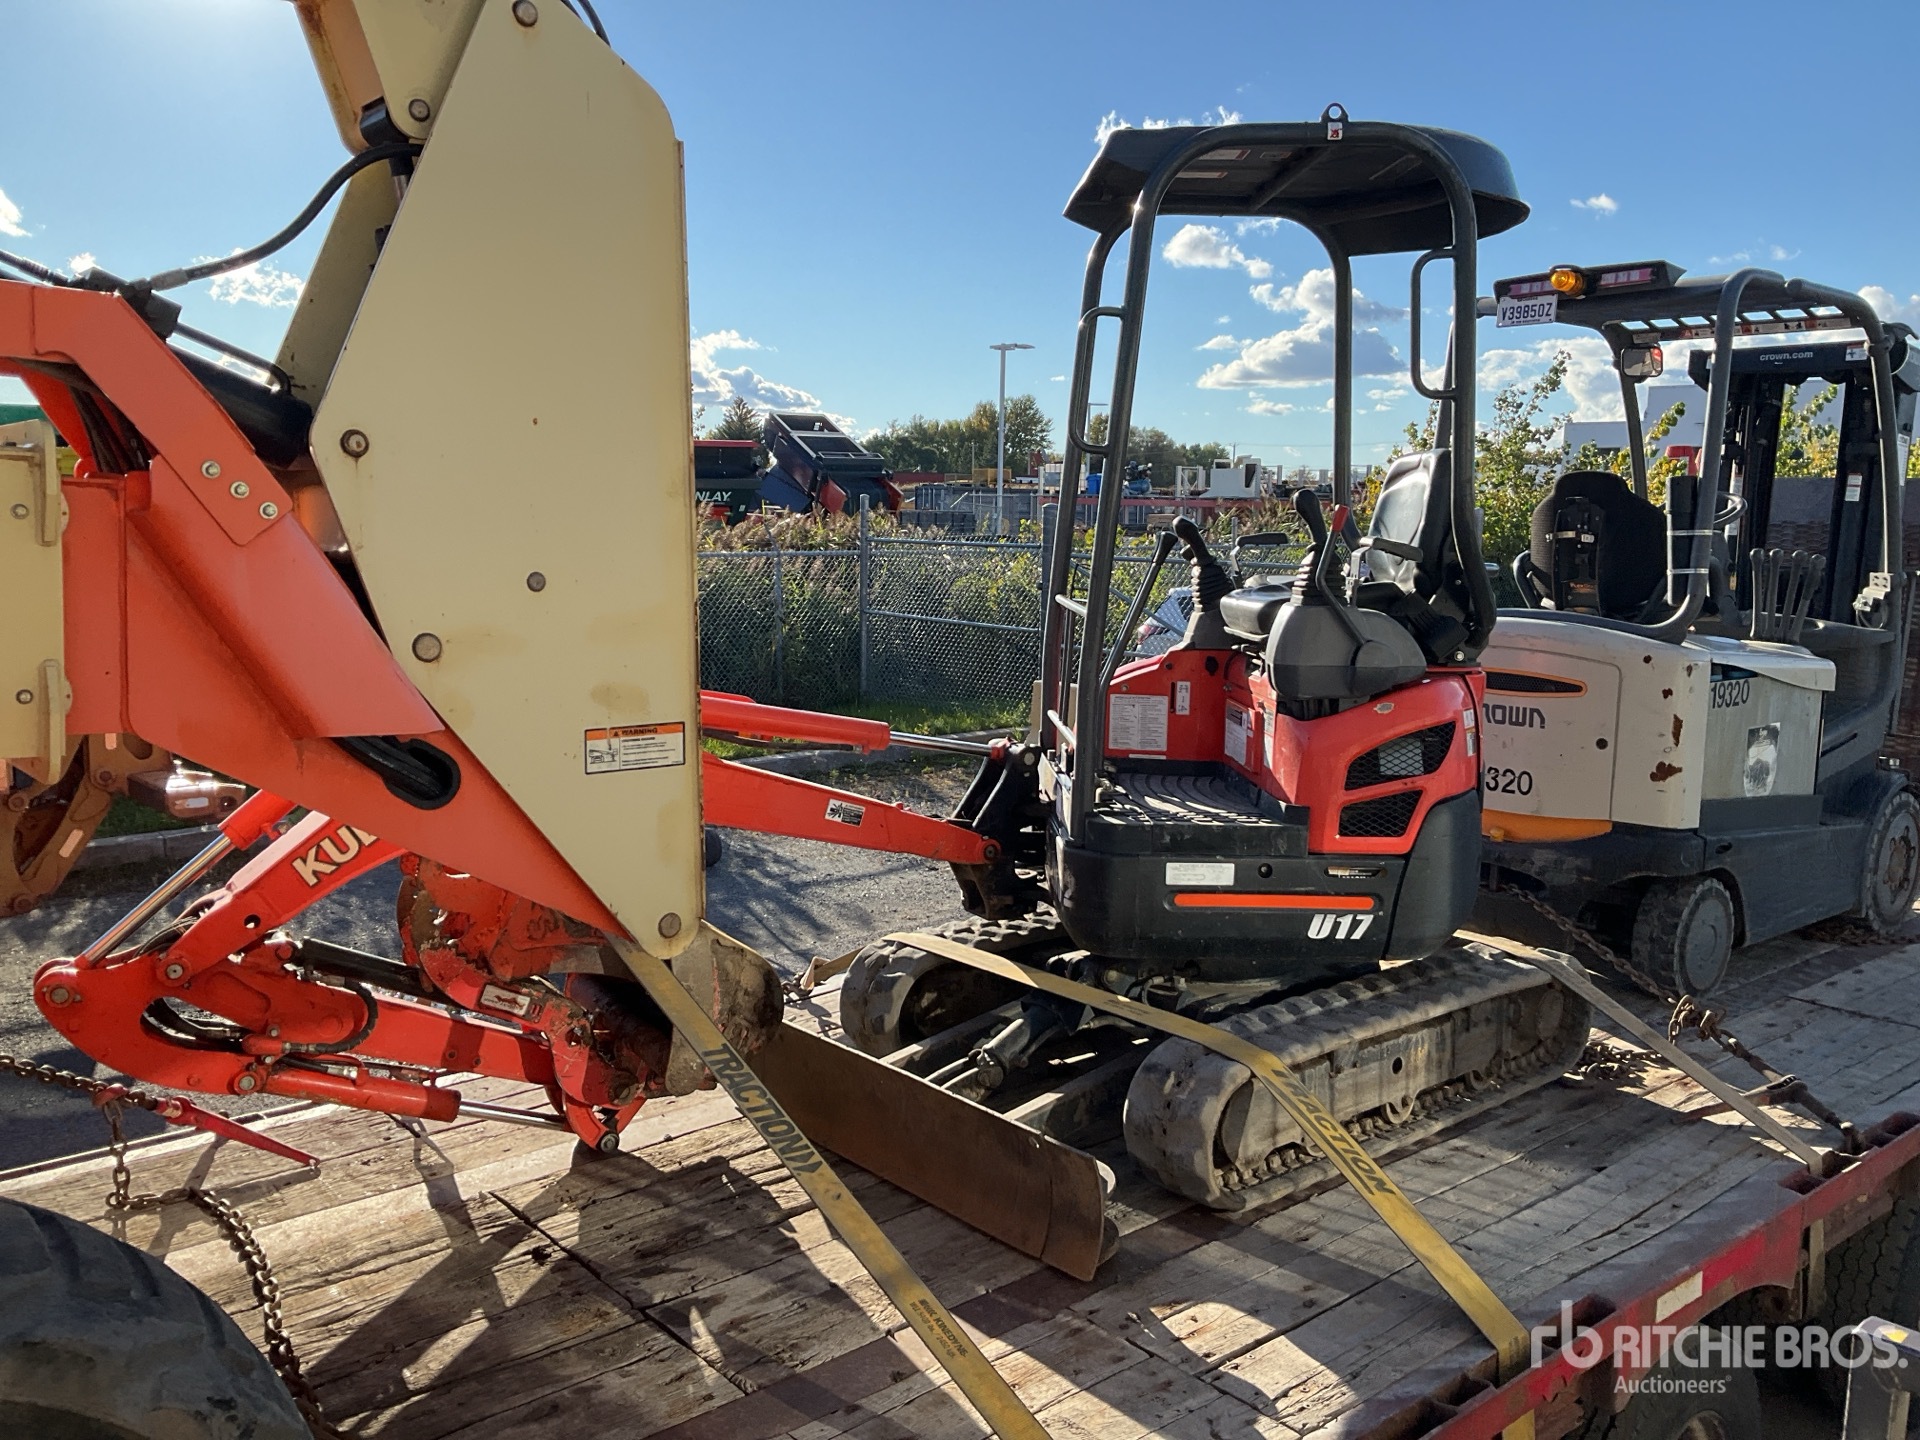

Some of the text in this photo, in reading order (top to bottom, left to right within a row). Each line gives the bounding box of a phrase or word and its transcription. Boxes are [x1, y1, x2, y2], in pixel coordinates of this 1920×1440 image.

[1760, 351, 1814, 361] crown.com
[1710, 679, 1750, 709] 19320
[621, 727, 658, 735] WARNING
[1485, 766, 1533, 796] 320
[292, 826, 378, 887] KU
[1307, 913, 1374, 939] U17
[701, 1042, 812, 1157] TRACTION
